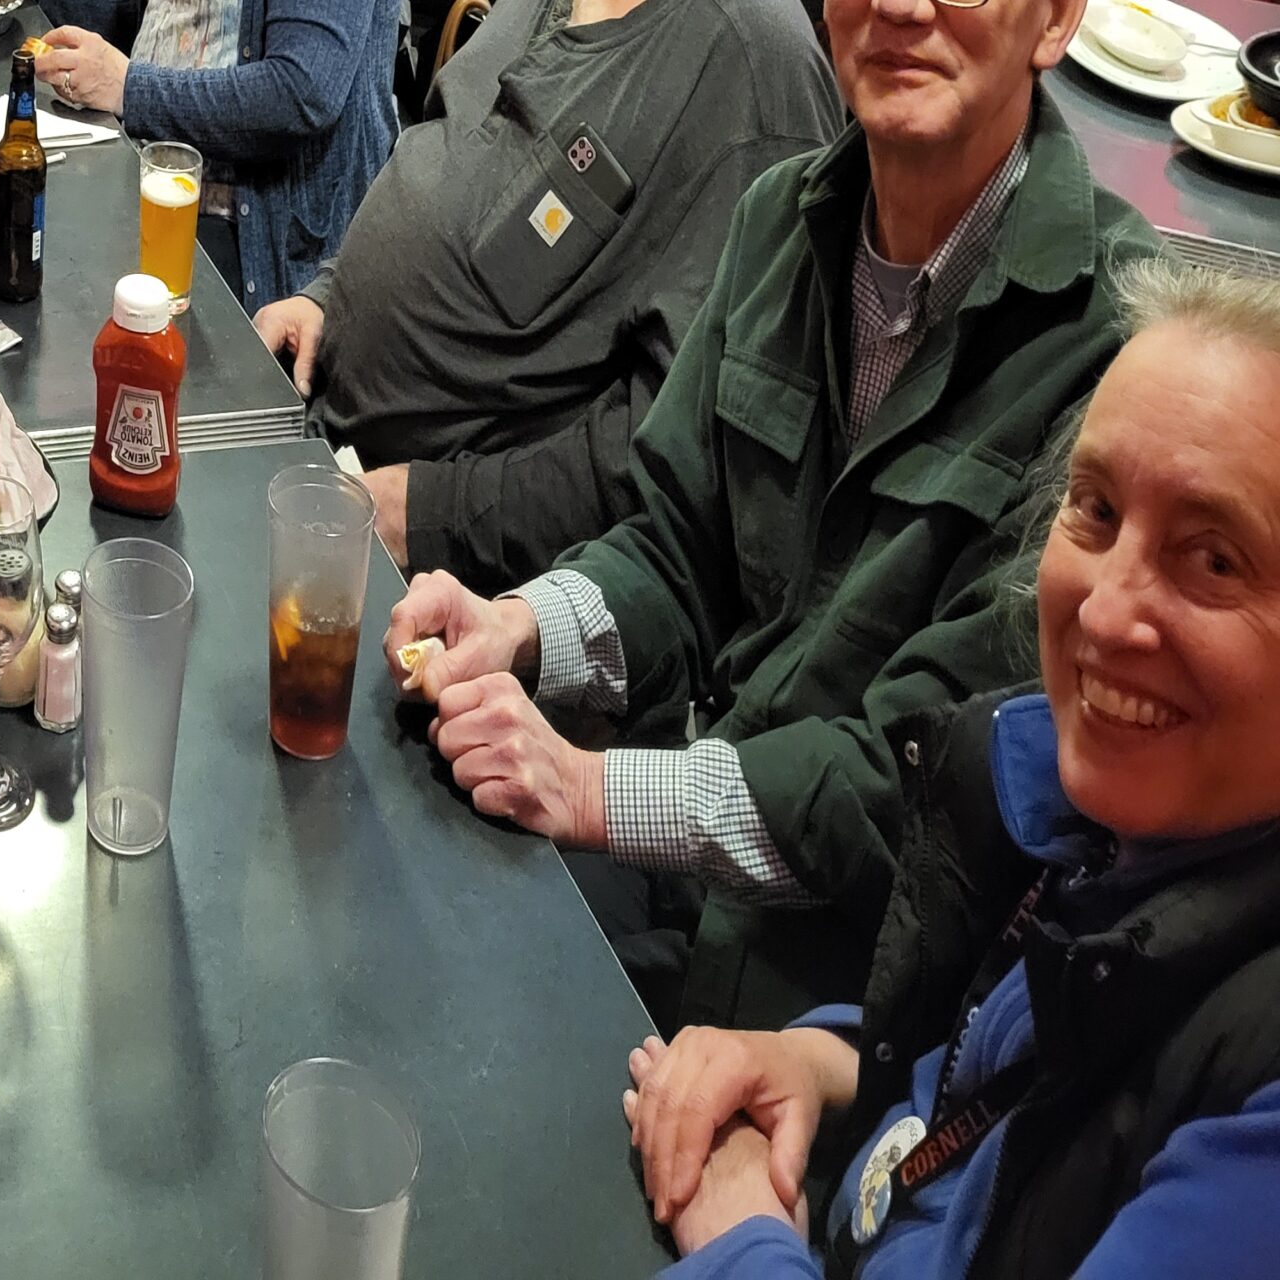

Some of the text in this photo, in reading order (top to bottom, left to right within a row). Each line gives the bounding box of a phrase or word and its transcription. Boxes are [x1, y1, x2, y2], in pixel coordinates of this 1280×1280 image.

[122, 425, 152, 436] KETCHUP
[120, 431, 153, 446] TOMATO
[122, 448, 151, 463] HEINZ
[901, 1100, 1000, 1186] CORNELL
